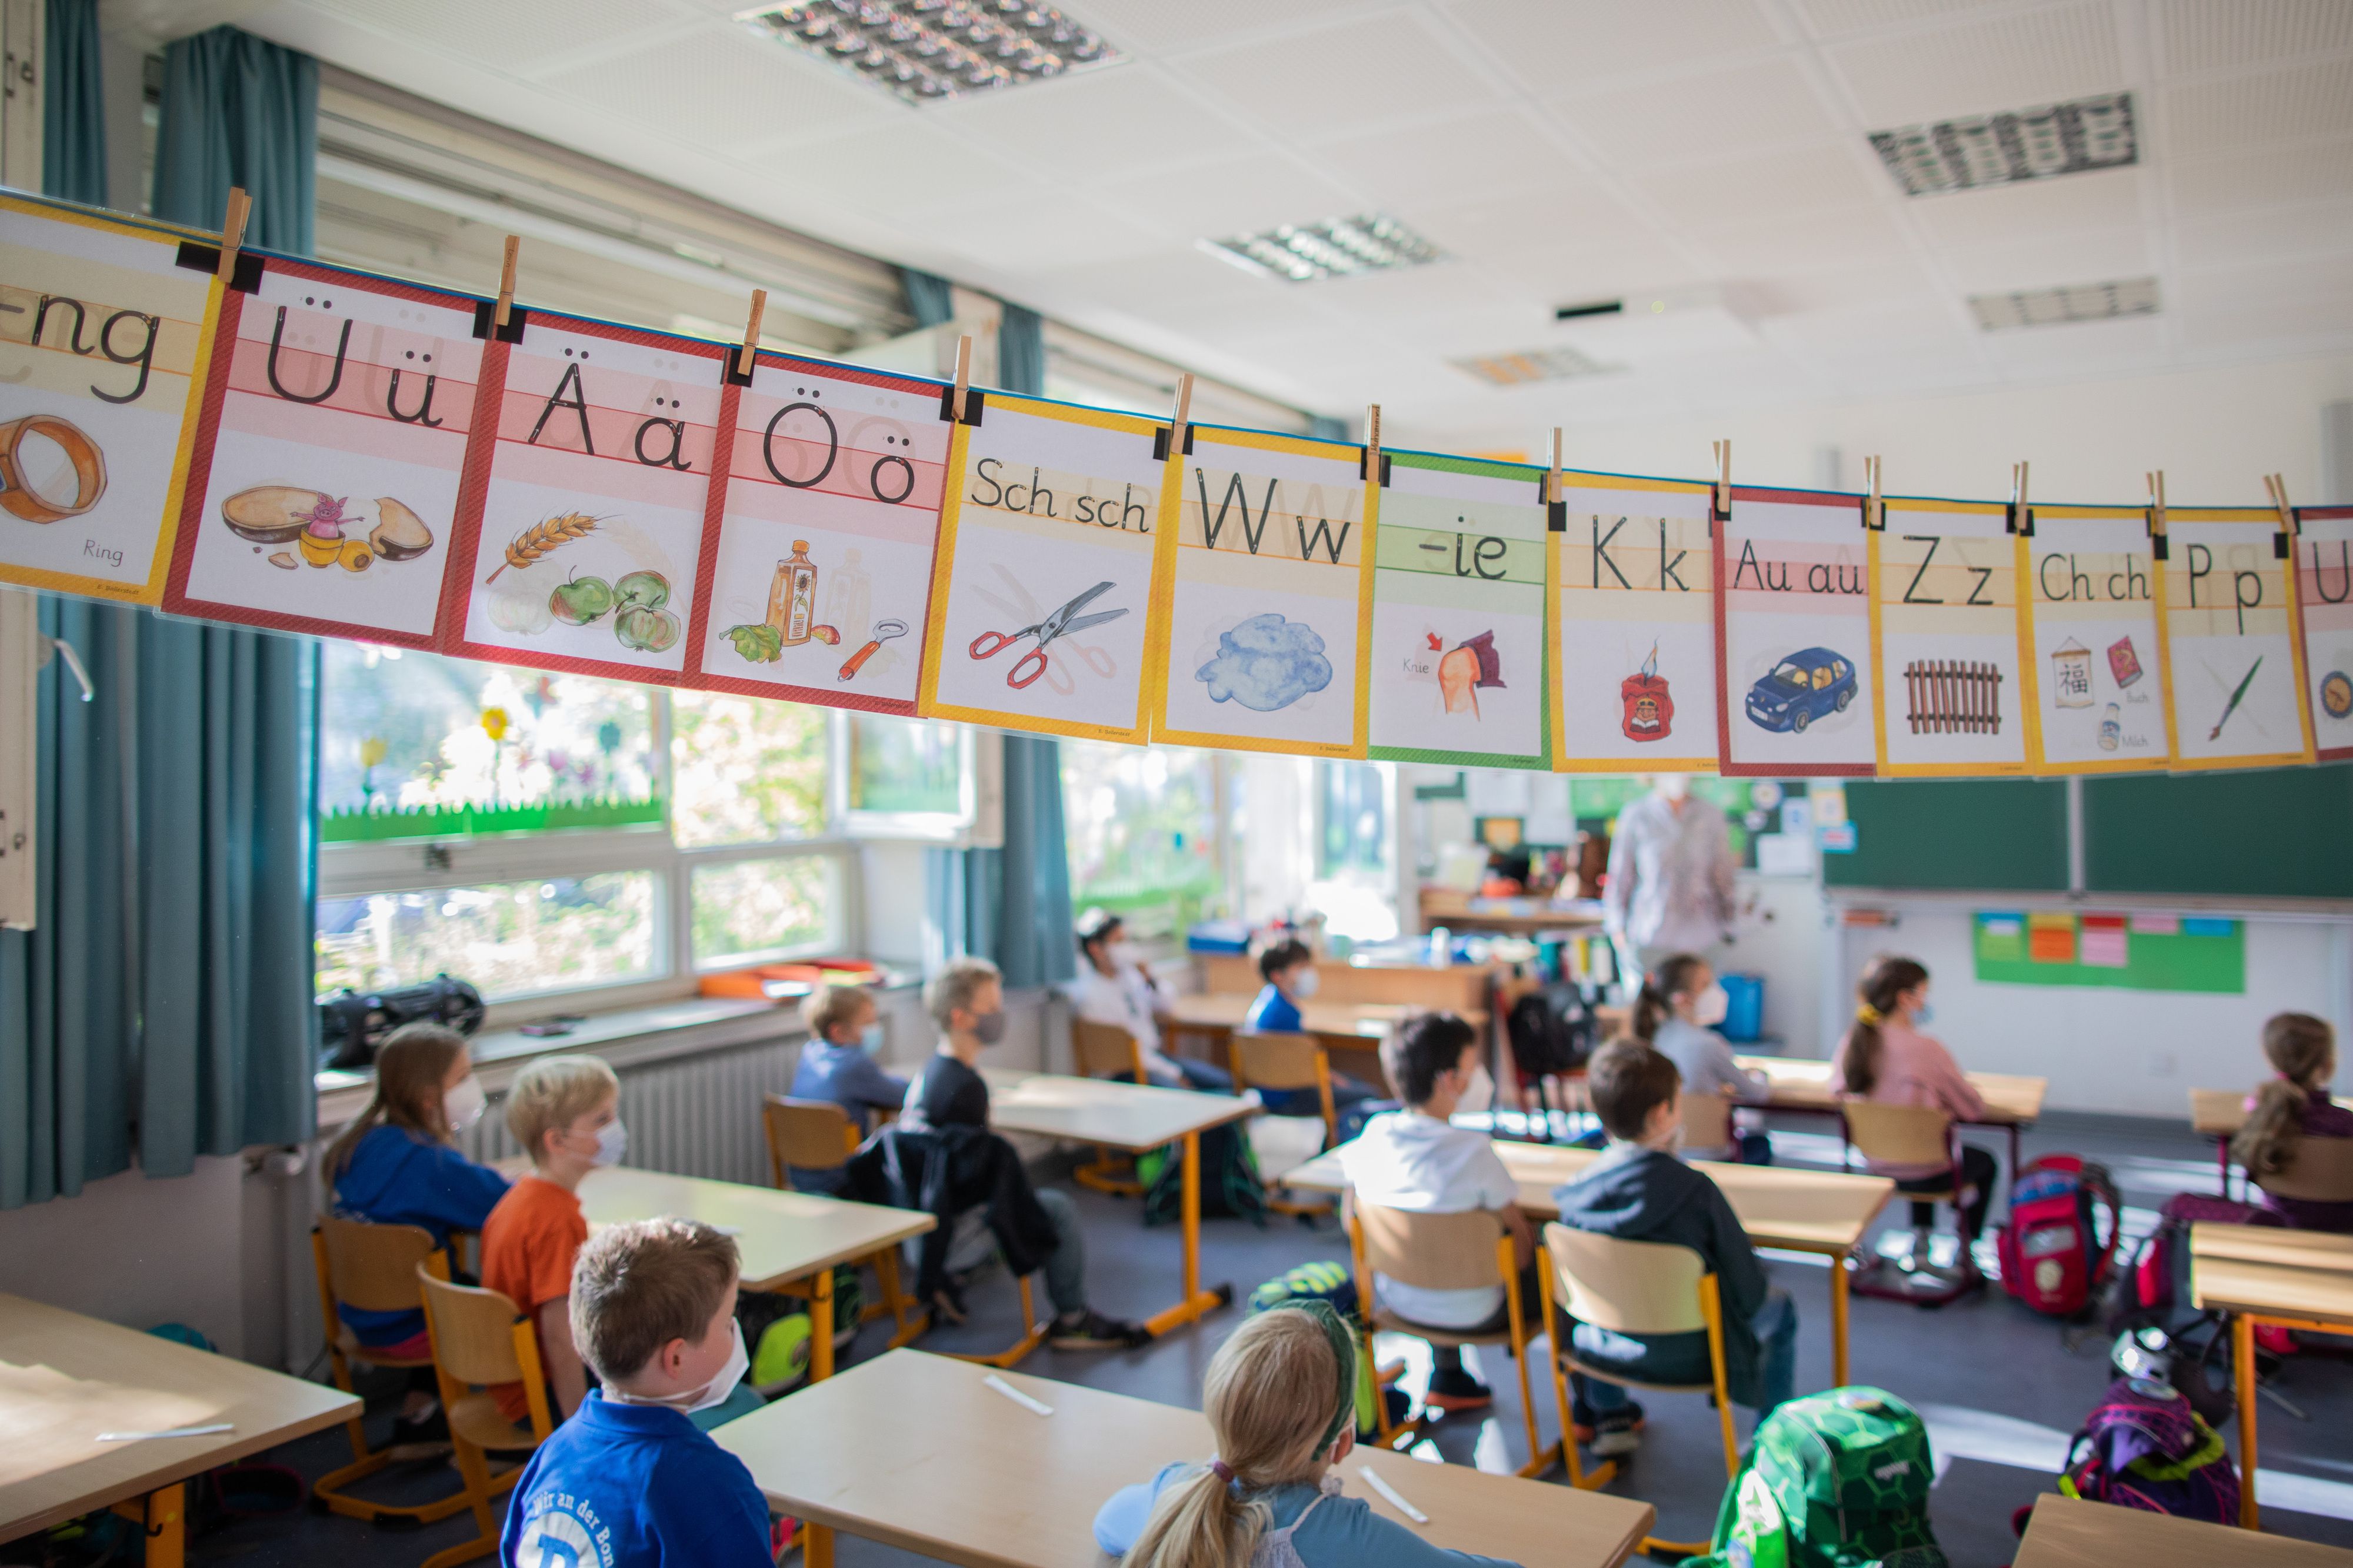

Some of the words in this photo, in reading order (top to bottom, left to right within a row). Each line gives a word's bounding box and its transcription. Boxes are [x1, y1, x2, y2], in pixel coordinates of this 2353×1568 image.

[268, 296, 353, 404] Ü
[387, 351, 443, 427] ü
[528, 348, 595, 456] Ä
[635, 397, 692, 471] ä
[764, 387, 838, 488] Ö
[871, 436, 915, 504] ö
[971, 458, 1057, 518] Sch
[1075, 483, 1149, 533] sch
[1195, 468, 1278, 555] W
[1297, 516, 1351, 564] w
[84, 539, 124, 568] Ring
[1419, 516, 1507, 580] -ie
[1593, 515, 1632, 589] K
[1660, 518, 1690, 591] k
[1734, 539, 1792, 591] Au
[1808, 564, 1864, 594] au
[1903, 535, 1944, 604] Z
[1967, 567, 1994, 605] z
[2041, 553, 2095, 601] Ch
[2108, 553, 2151, 600] ch
[2313, 539, 2350, 603] U
[2187, 543, 2212, 608] P
[2234, 571, 2262, 636] p
[1402, 658, 1429, 673] Knie
[2059, 663, 2088, 696] 福
[2126, 690, 2149, 704] Buch
[2122, 735, 2148, 748] Milch
[533, 1490, 555, 1515] Wir
[557, 1492, 575, 1510] an
[576, 1499, 601, 1530] der
